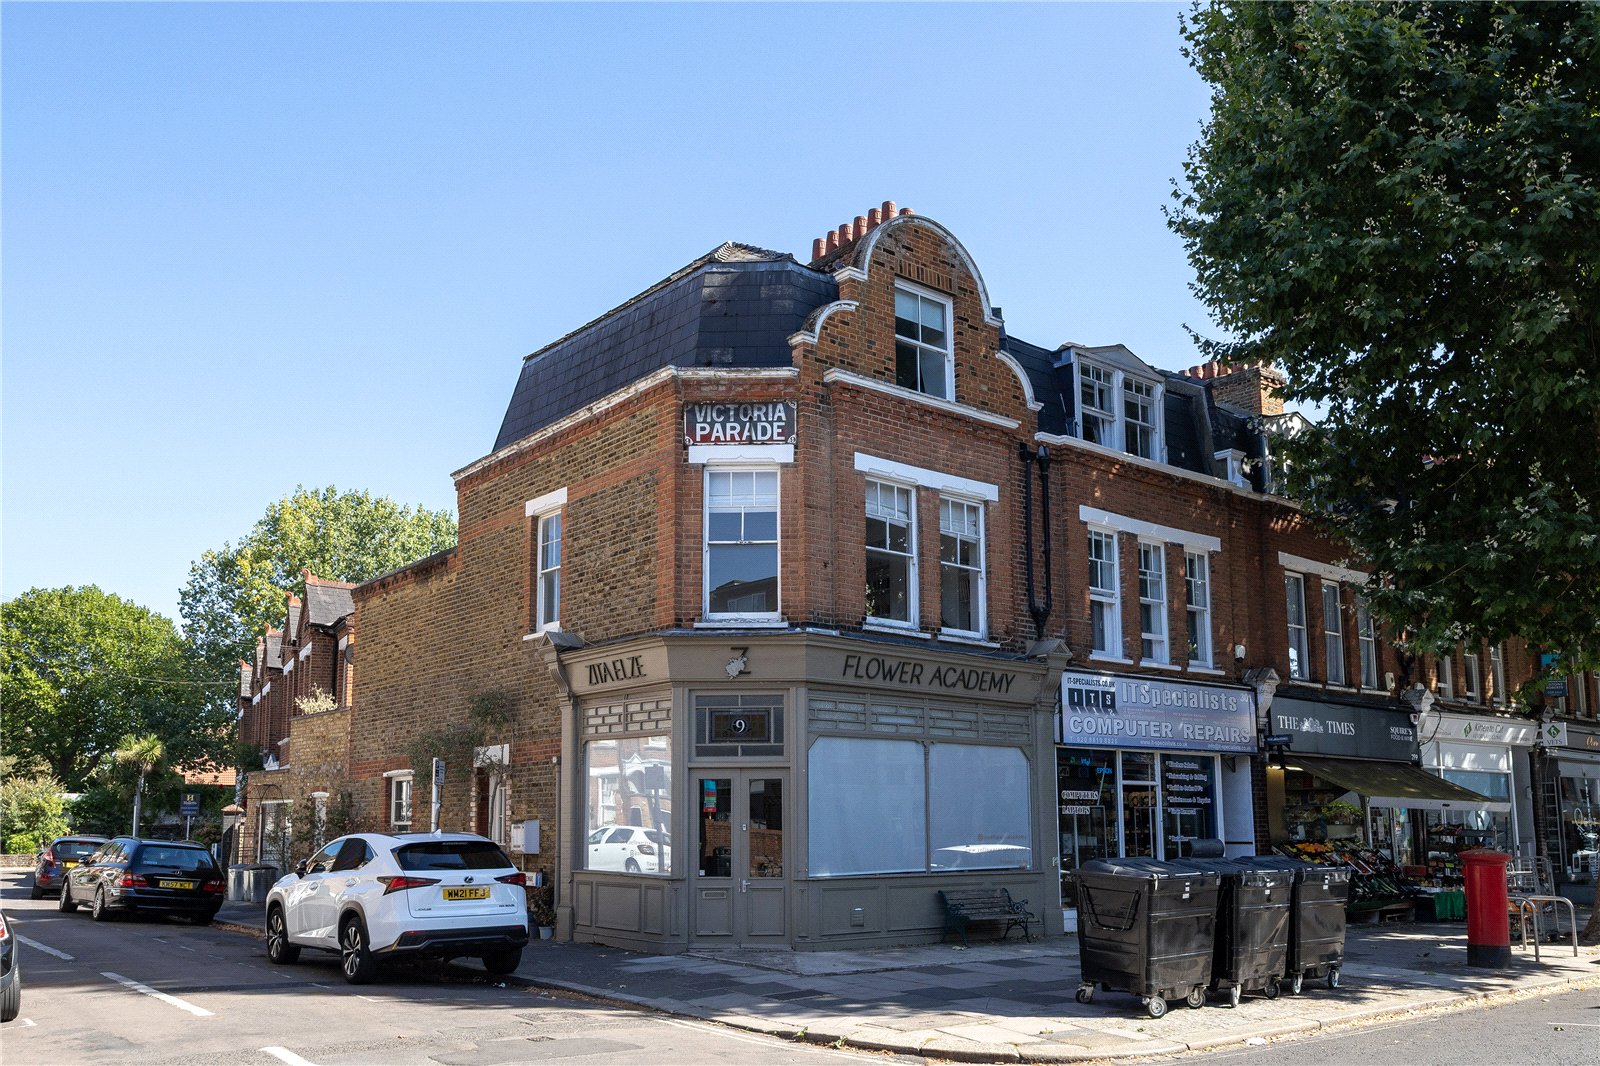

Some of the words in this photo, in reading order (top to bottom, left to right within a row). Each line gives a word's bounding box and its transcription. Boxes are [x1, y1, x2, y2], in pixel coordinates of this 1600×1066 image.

[695, 402, 786, 422] VICTORIA
[695, 421, 786, 442] PARADE
[842, 655, 924, 685] FLOWER
[928, 665, 1016, 694] ACADEMY
[1067, 677, 1116, 688] IT-SPECIALISTS.CO.UK
[1122, 681, 1237, 712] ITSpecialists
[736, 719, 745, 733] 9
[1069, 716, 1173, 738] COMPUTER
[1183, 723, 1250, 743] REPAIRS
[1277, 715, 1299, 730] THE
[1326, 720, 1355, 736] TIMES
[1389, 726, 1412, 736] SQUIRE'S
[1061, 790, 1098, 799] COMPUTERS
[1062, 805, 1090, 815] LAPTOPS
[448, 889, 467, 898] WM21
[468, 888, 486, 897] FFJ
